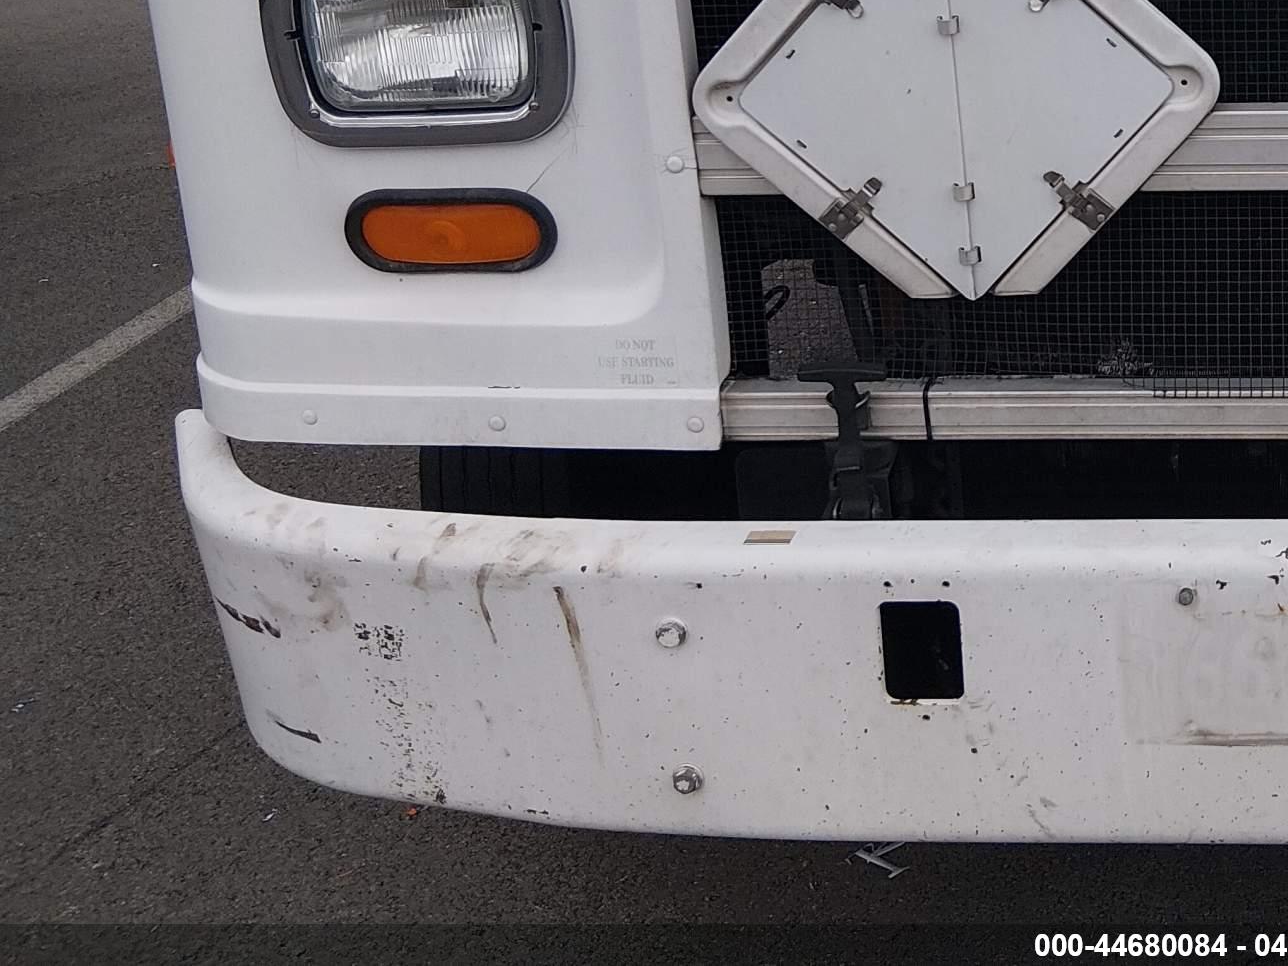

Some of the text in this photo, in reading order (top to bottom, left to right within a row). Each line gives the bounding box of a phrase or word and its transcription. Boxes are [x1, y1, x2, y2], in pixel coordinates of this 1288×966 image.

[615, 339, 656, 351] DO NOT
[621, 355, 674, 369] STARTING
[620, 373, 655, 385] FLUID
